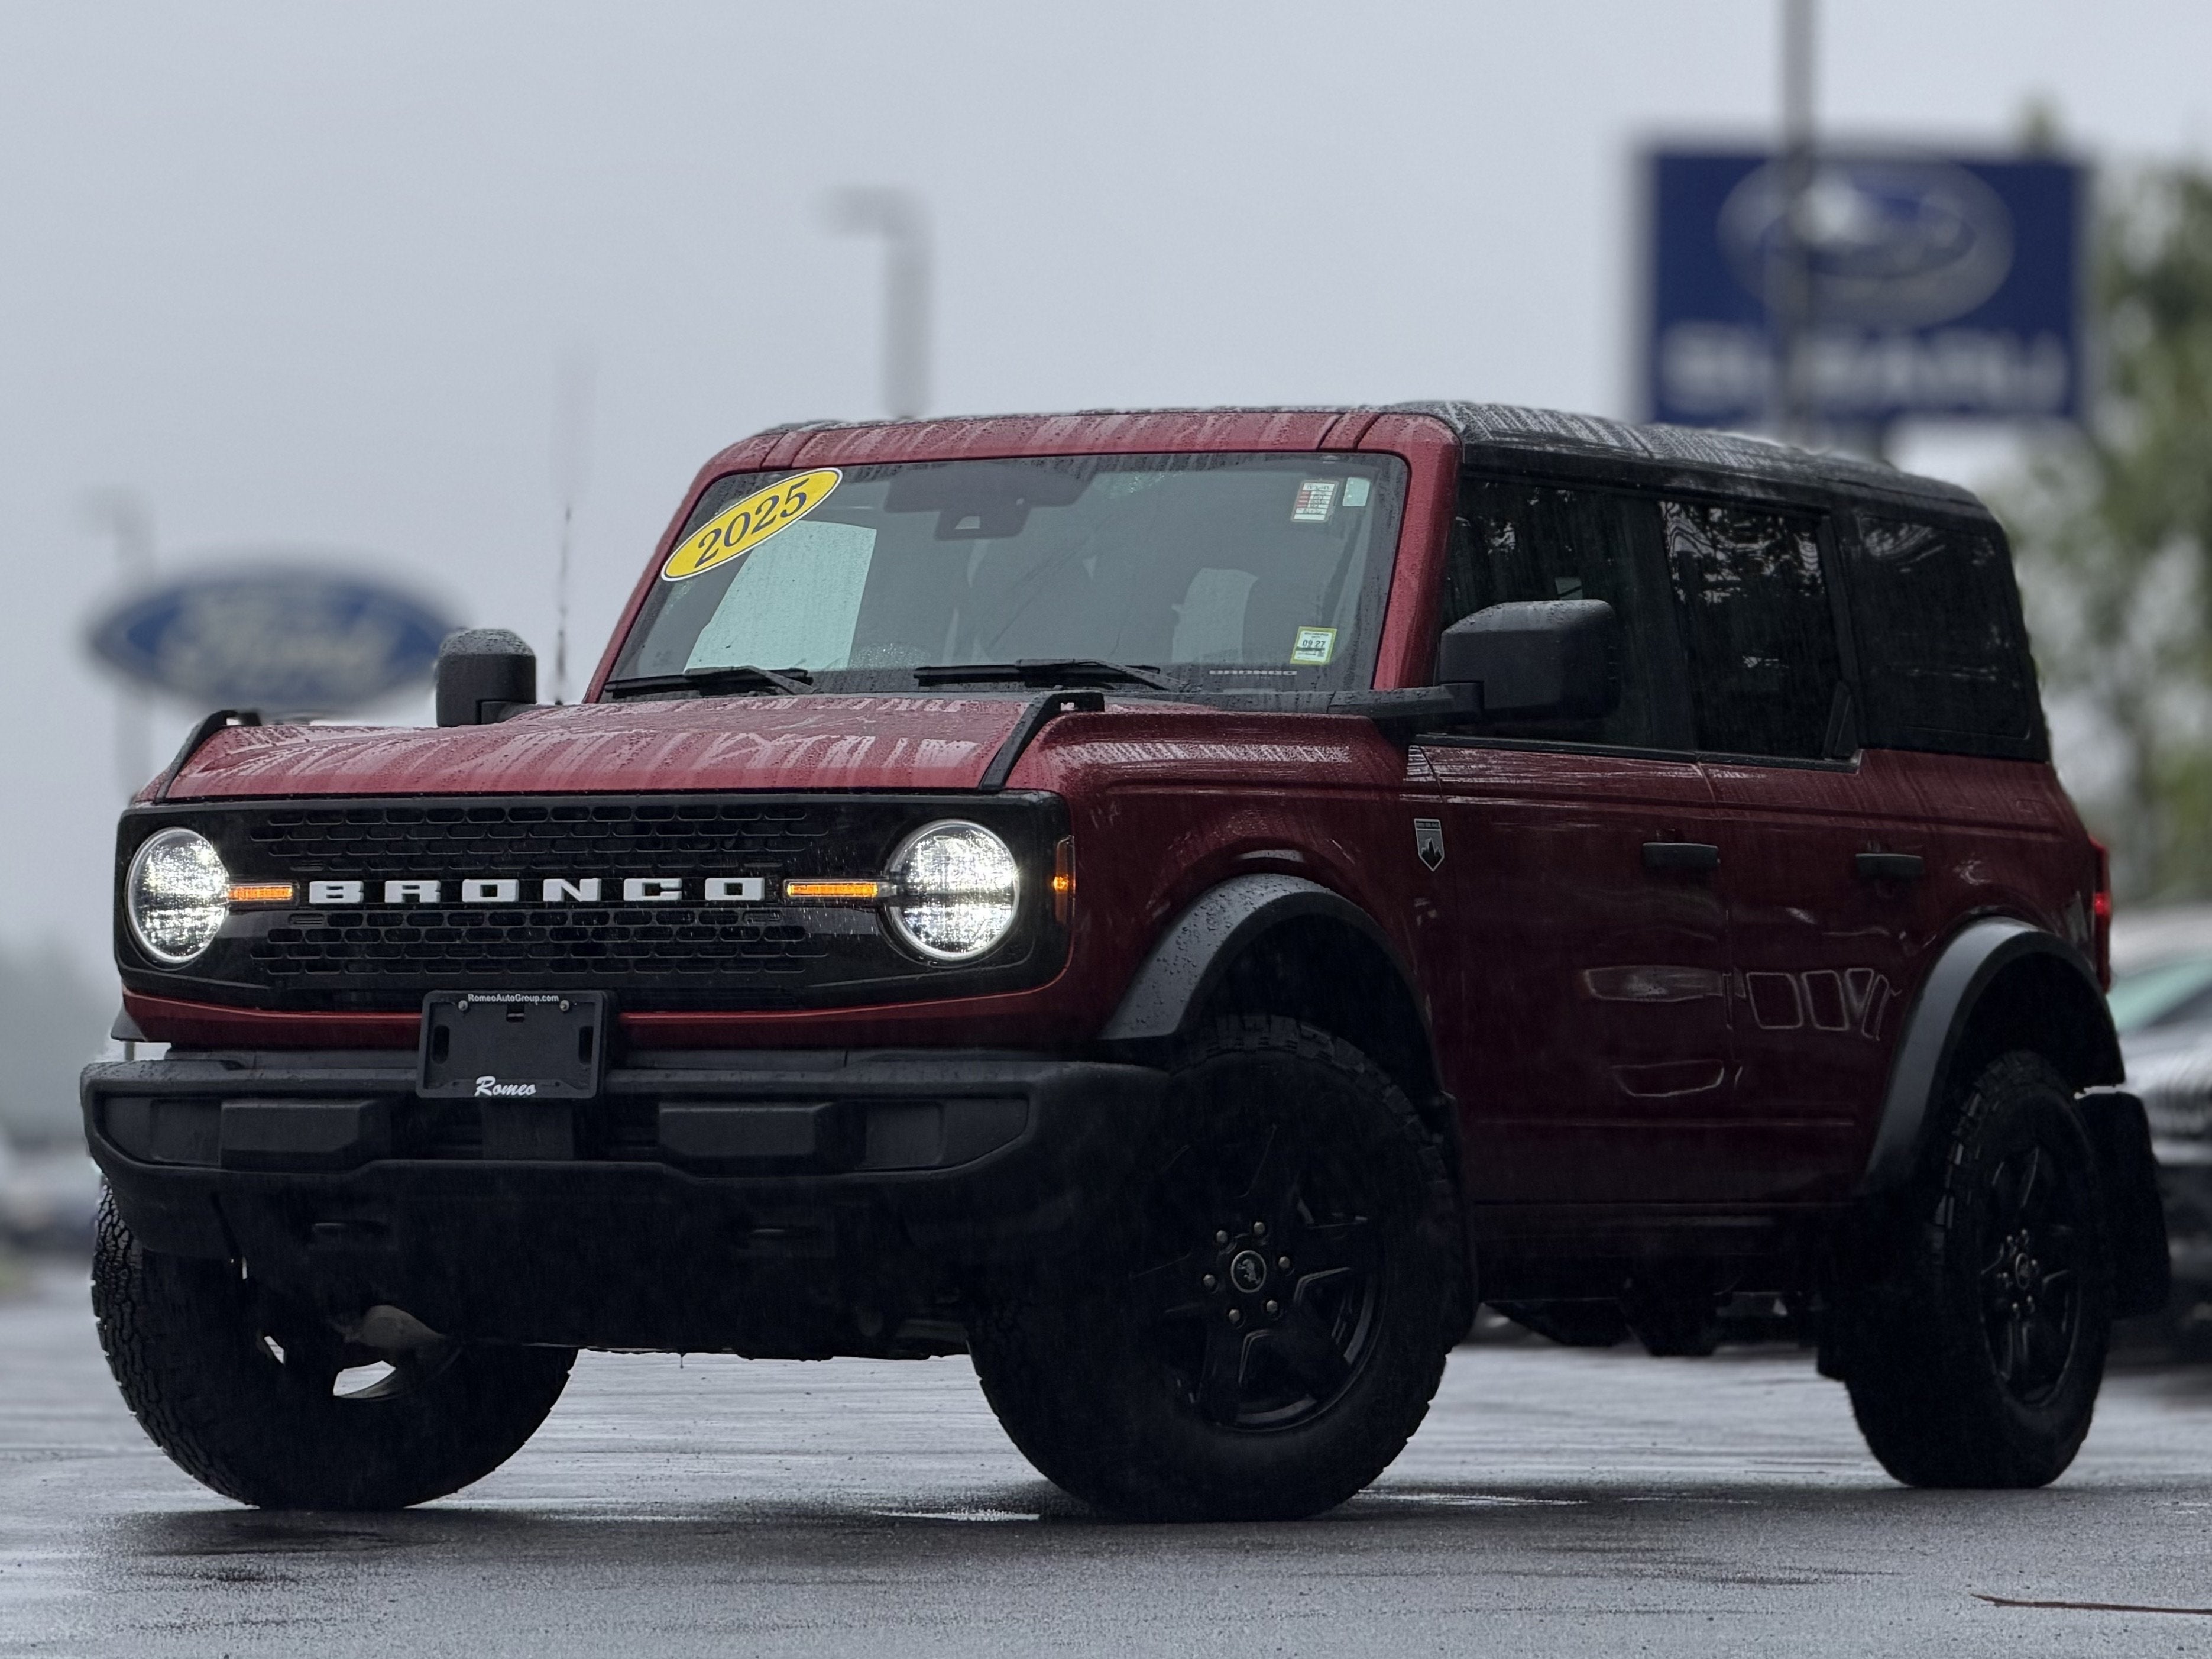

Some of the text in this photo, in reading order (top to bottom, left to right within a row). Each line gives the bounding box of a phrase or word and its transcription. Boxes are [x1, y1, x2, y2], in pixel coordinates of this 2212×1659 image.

[694, 478, 809, 568] 2025
[309, 877, 765, 904] BRONCO
[468, 994, 559, 1005] RomeoAutoGroup.com
[474, 1075, 536, 1097] Romeo
